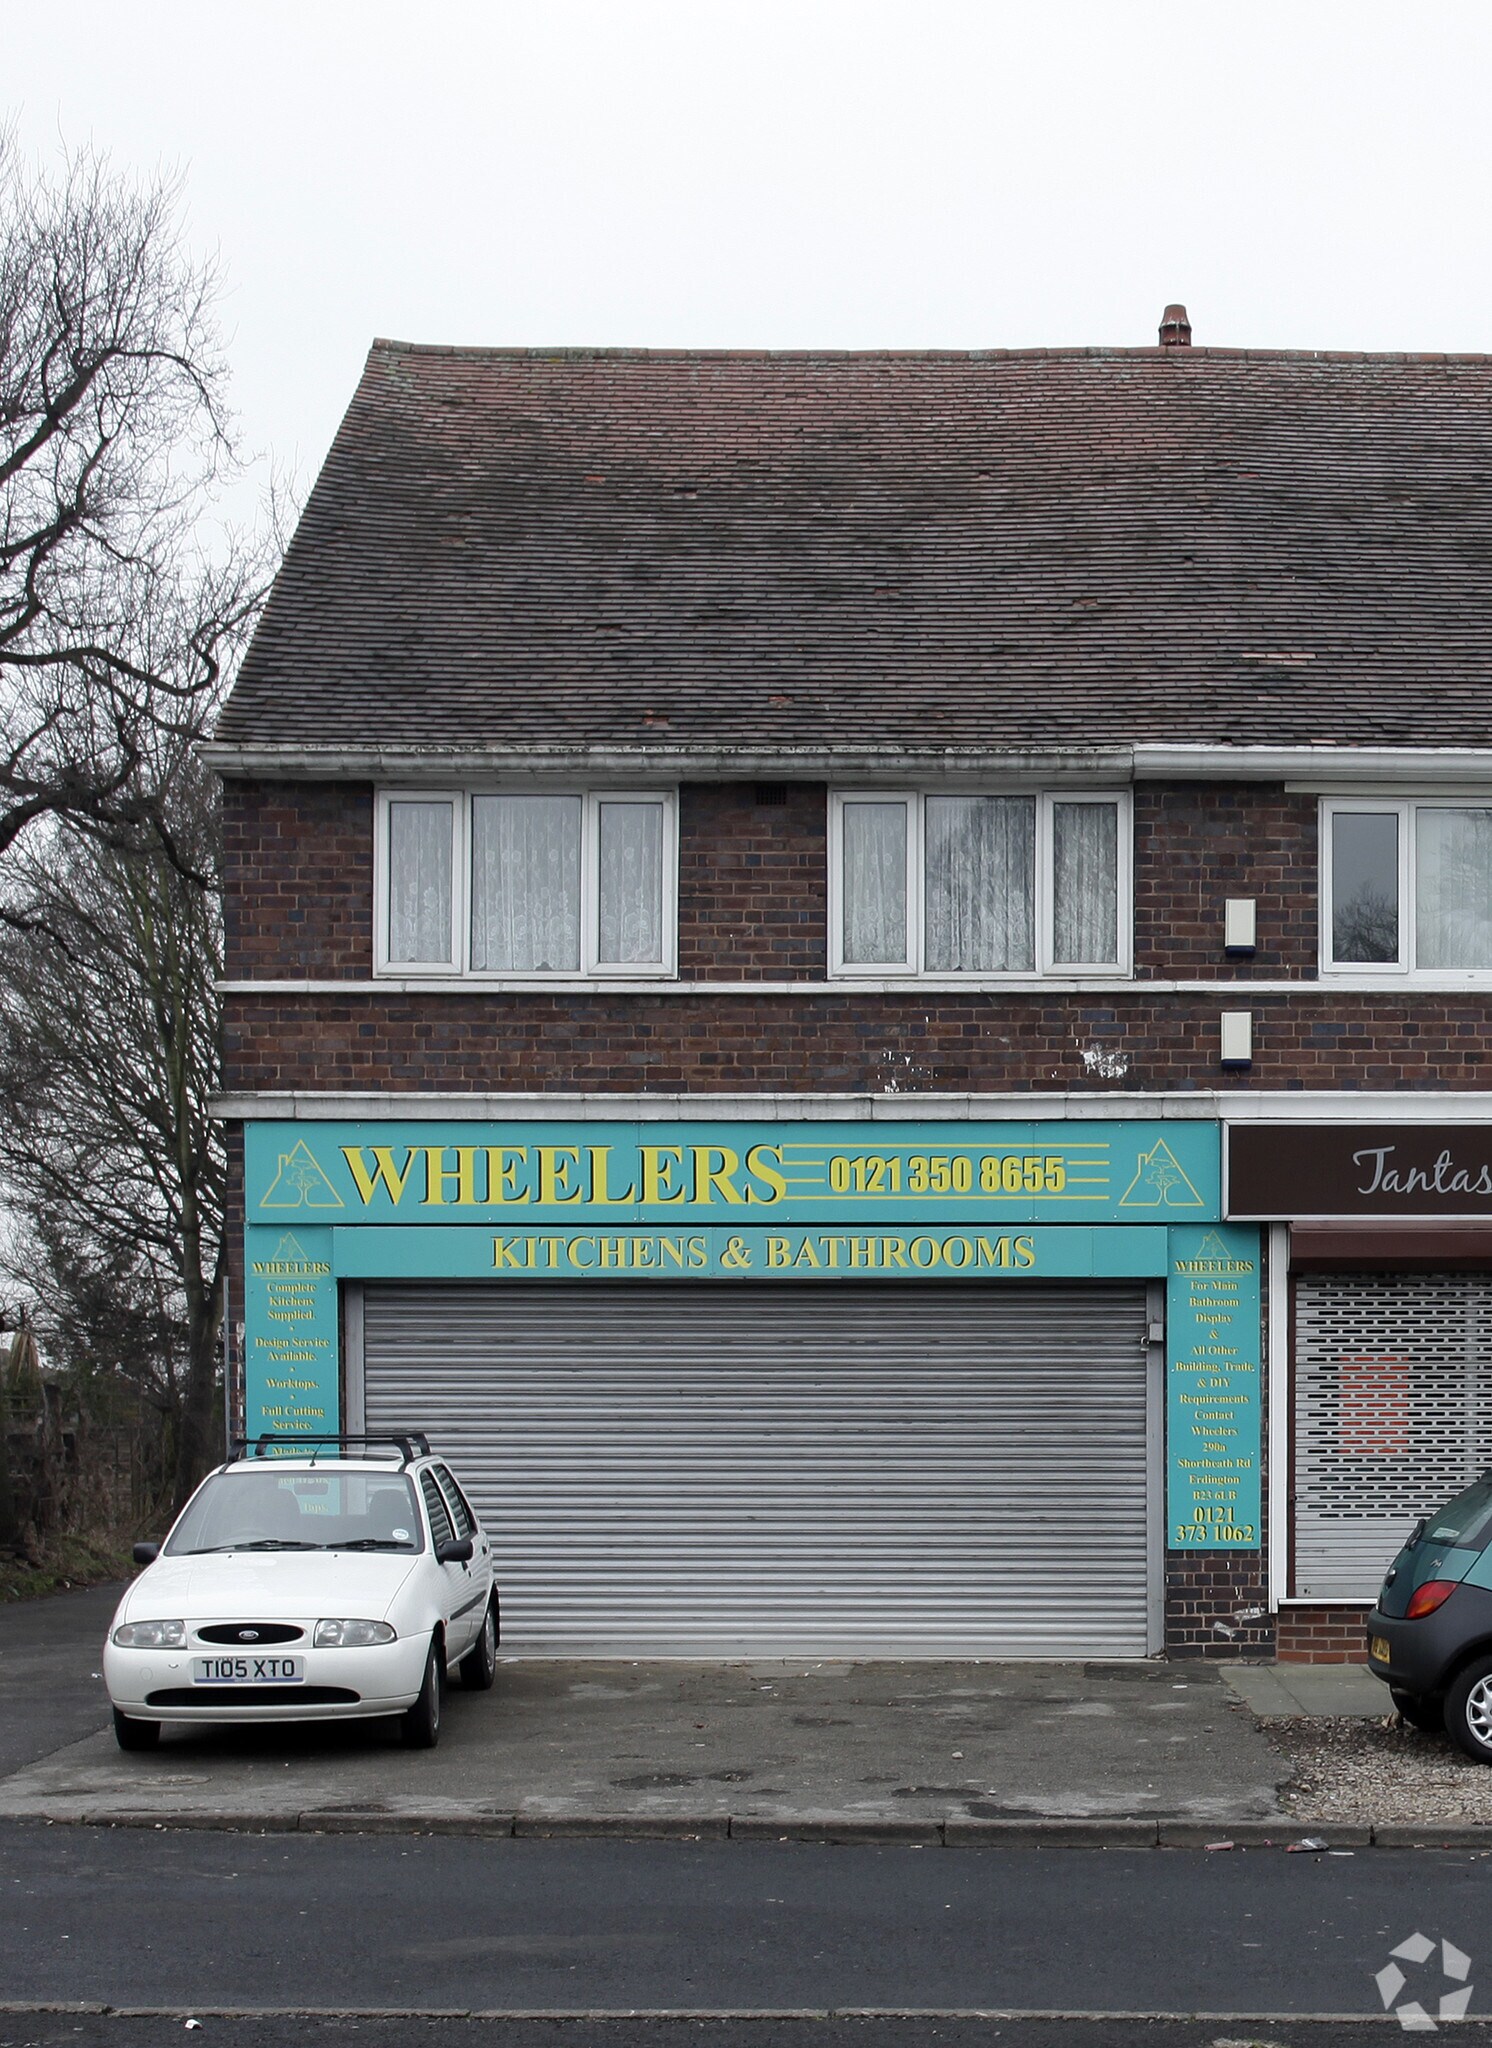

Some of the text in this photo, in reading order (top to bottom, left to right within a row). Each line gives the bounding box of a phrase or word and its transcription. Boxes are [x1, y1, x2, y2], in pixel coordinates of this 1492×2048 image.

[338, 1143, 787, 1206] WHEELERS
[828, 1154, 1067, 1193] 0121 350 8655
[490, 1236, 1036, 1269] KITCHENS & BATHROOMS
[252, 1261, 331, 1274] WHEELERS
[1174, 1259, 1255, 1272] WHEELERS
[267, 1281, 317, 1294] Complete
[1190, 1280, 1239, 1291] For Main
[269, 1295, 316, 1307] Kitchens
[1189, 1296, 1240, 1307] Bathroom
[1195, 1312, 1233, 1326] Display
[1208, 1328, 1219, 1340] &
[255, 1337, 330, 1351] Design Service
[1190, 1344, 1239, 1355] All Other
[267, 1351, 318, 1362] Available.
[265, 1378, 320, 1391] Worktops.
[1197, 1377, 1231, 1388] & DIY
[1179, 1393, 1250, 1406] Requirements
[261, 1405, 326, 1419] Full Cutting
[1194, 1409, 1235, 1420] Contact
[272, 1419, 314, 1431] Service.
[1191, 1425, 1239, 1437] Wheelers
[1177, 1457, 1252, 1469] Shortheath Rd
[1188, 1474, 1241, 1487] Erdington
[1192, 1489, 1213, 1501] B23
[1193, 1505, 1235, 1524] 0121
[1174, 1523, 1255, 1543] 373 1062
[202, 1660, 295, 1678] T105 XTO
